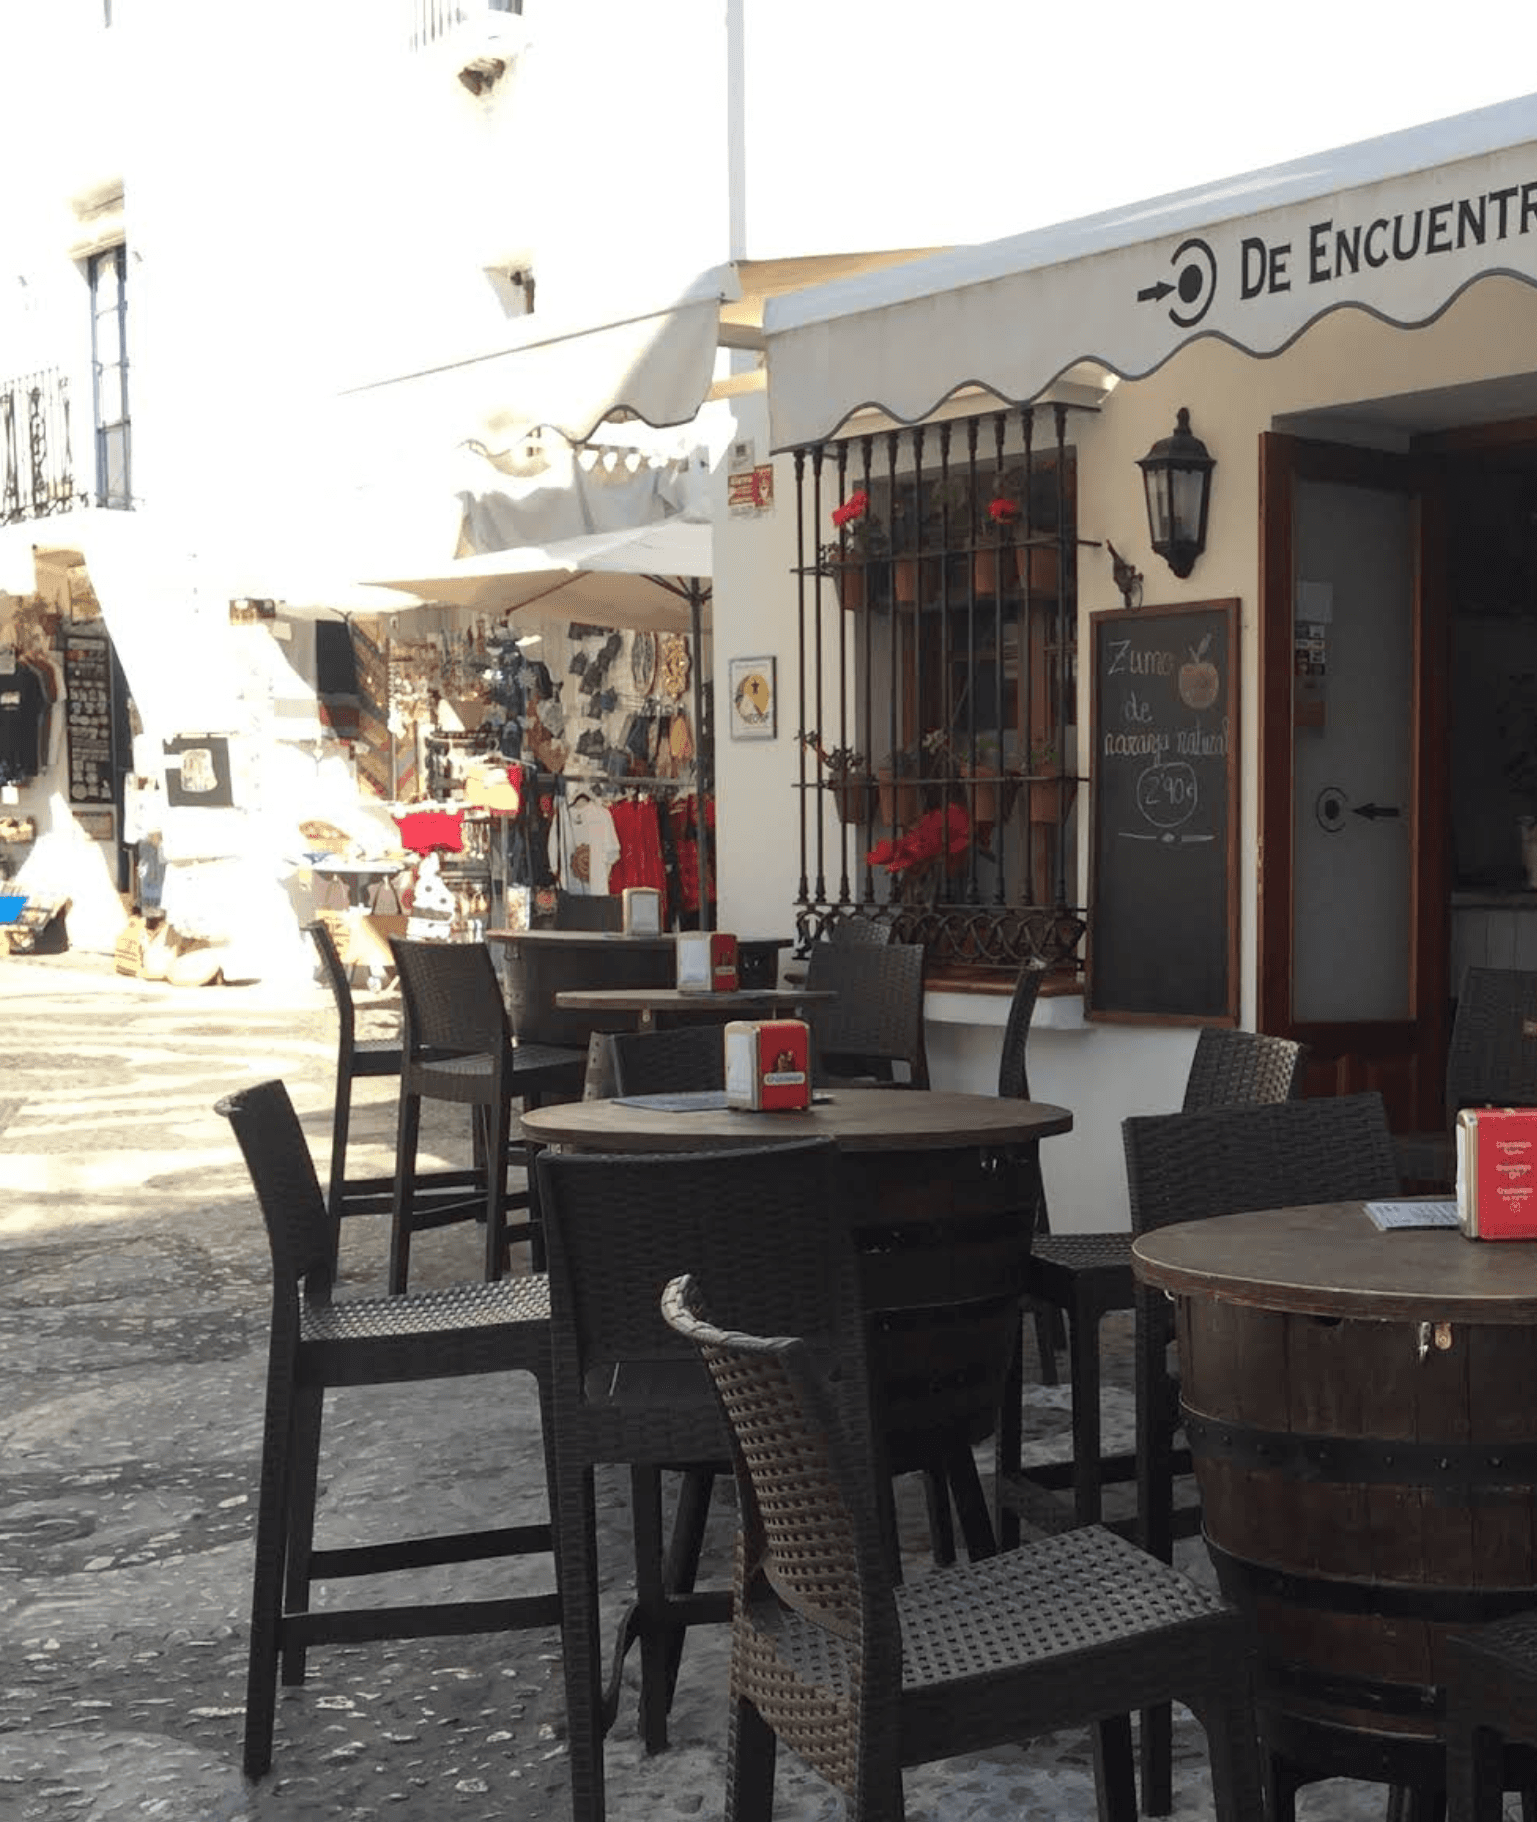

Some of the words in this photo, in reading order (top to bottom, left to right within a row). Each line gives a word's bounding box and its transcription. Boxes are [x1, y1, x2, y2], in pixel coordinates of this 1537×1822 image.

[1107, 639, 1174, 676] Zumo
[1124, 689, 1153, 723] de
[1104, 731, 1170, 767] naranja
[1176, 715, 1230, 757] natural
